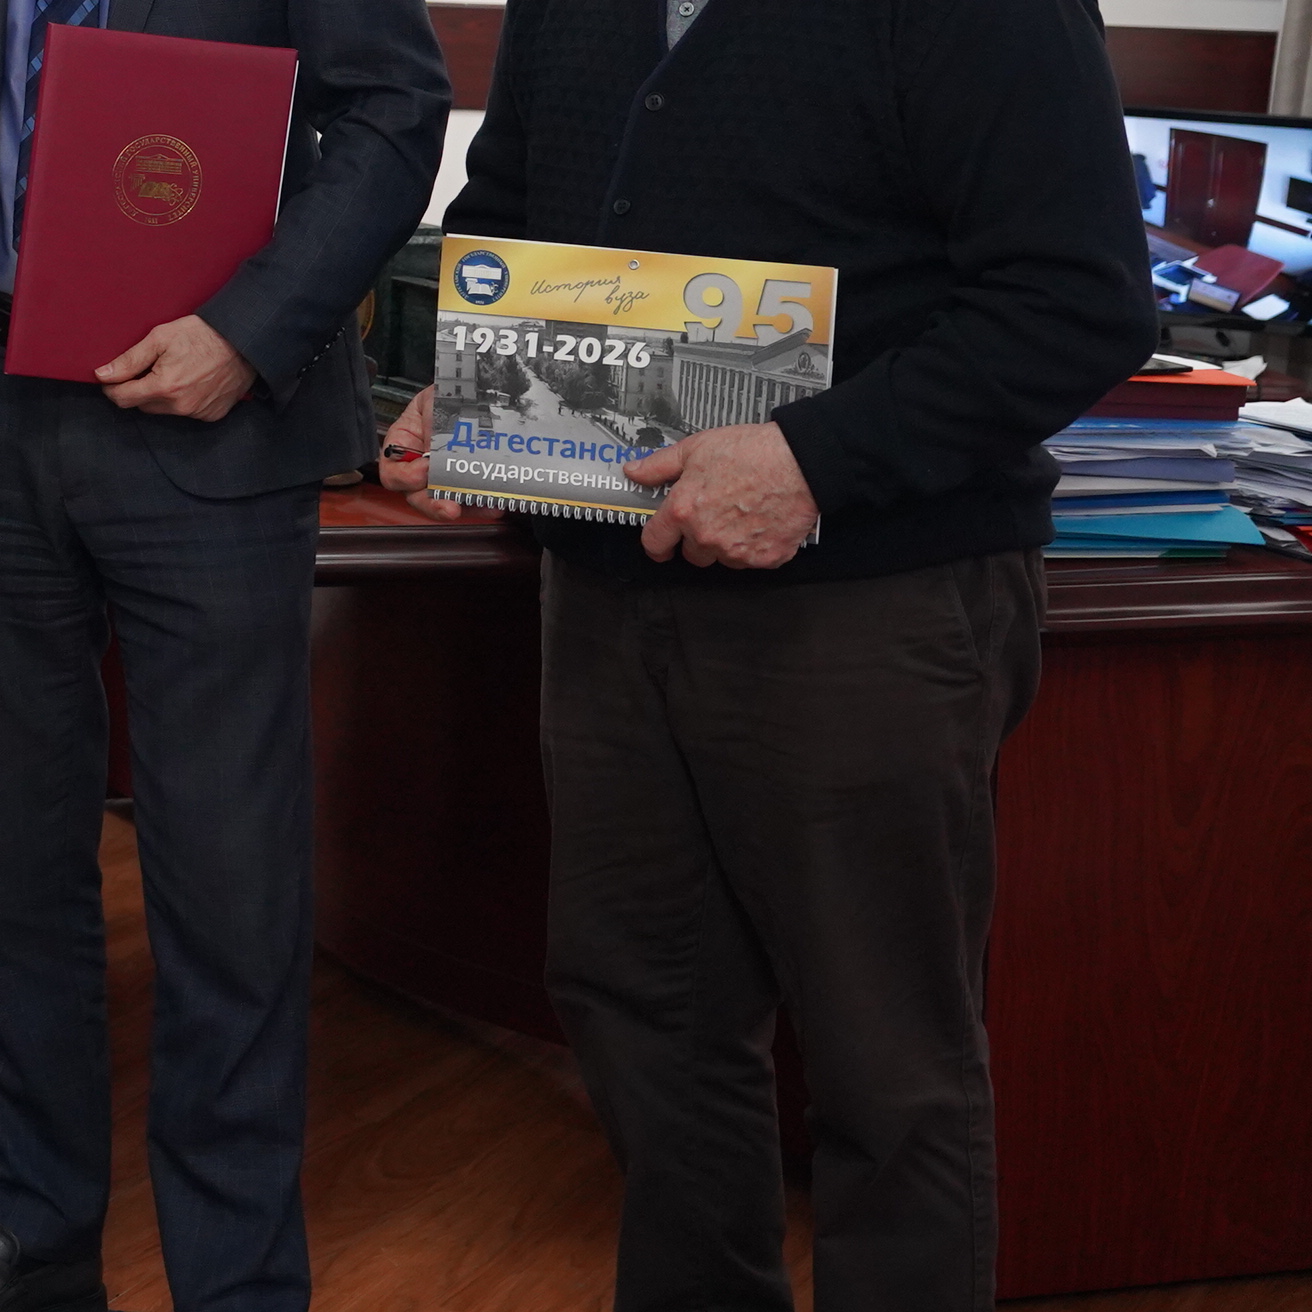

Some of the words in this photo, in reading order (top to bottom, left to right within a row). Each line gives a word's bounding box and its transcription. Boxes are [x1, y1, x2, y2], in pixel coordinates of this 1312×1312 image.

[530, 274, 622, 303] История
[605, 288, 650, 316] вуза
[683, 272, 814, 343] 95
[453, 325, 652, 369] 1931-2026
[447, 421, 672, 464] Дагестански
